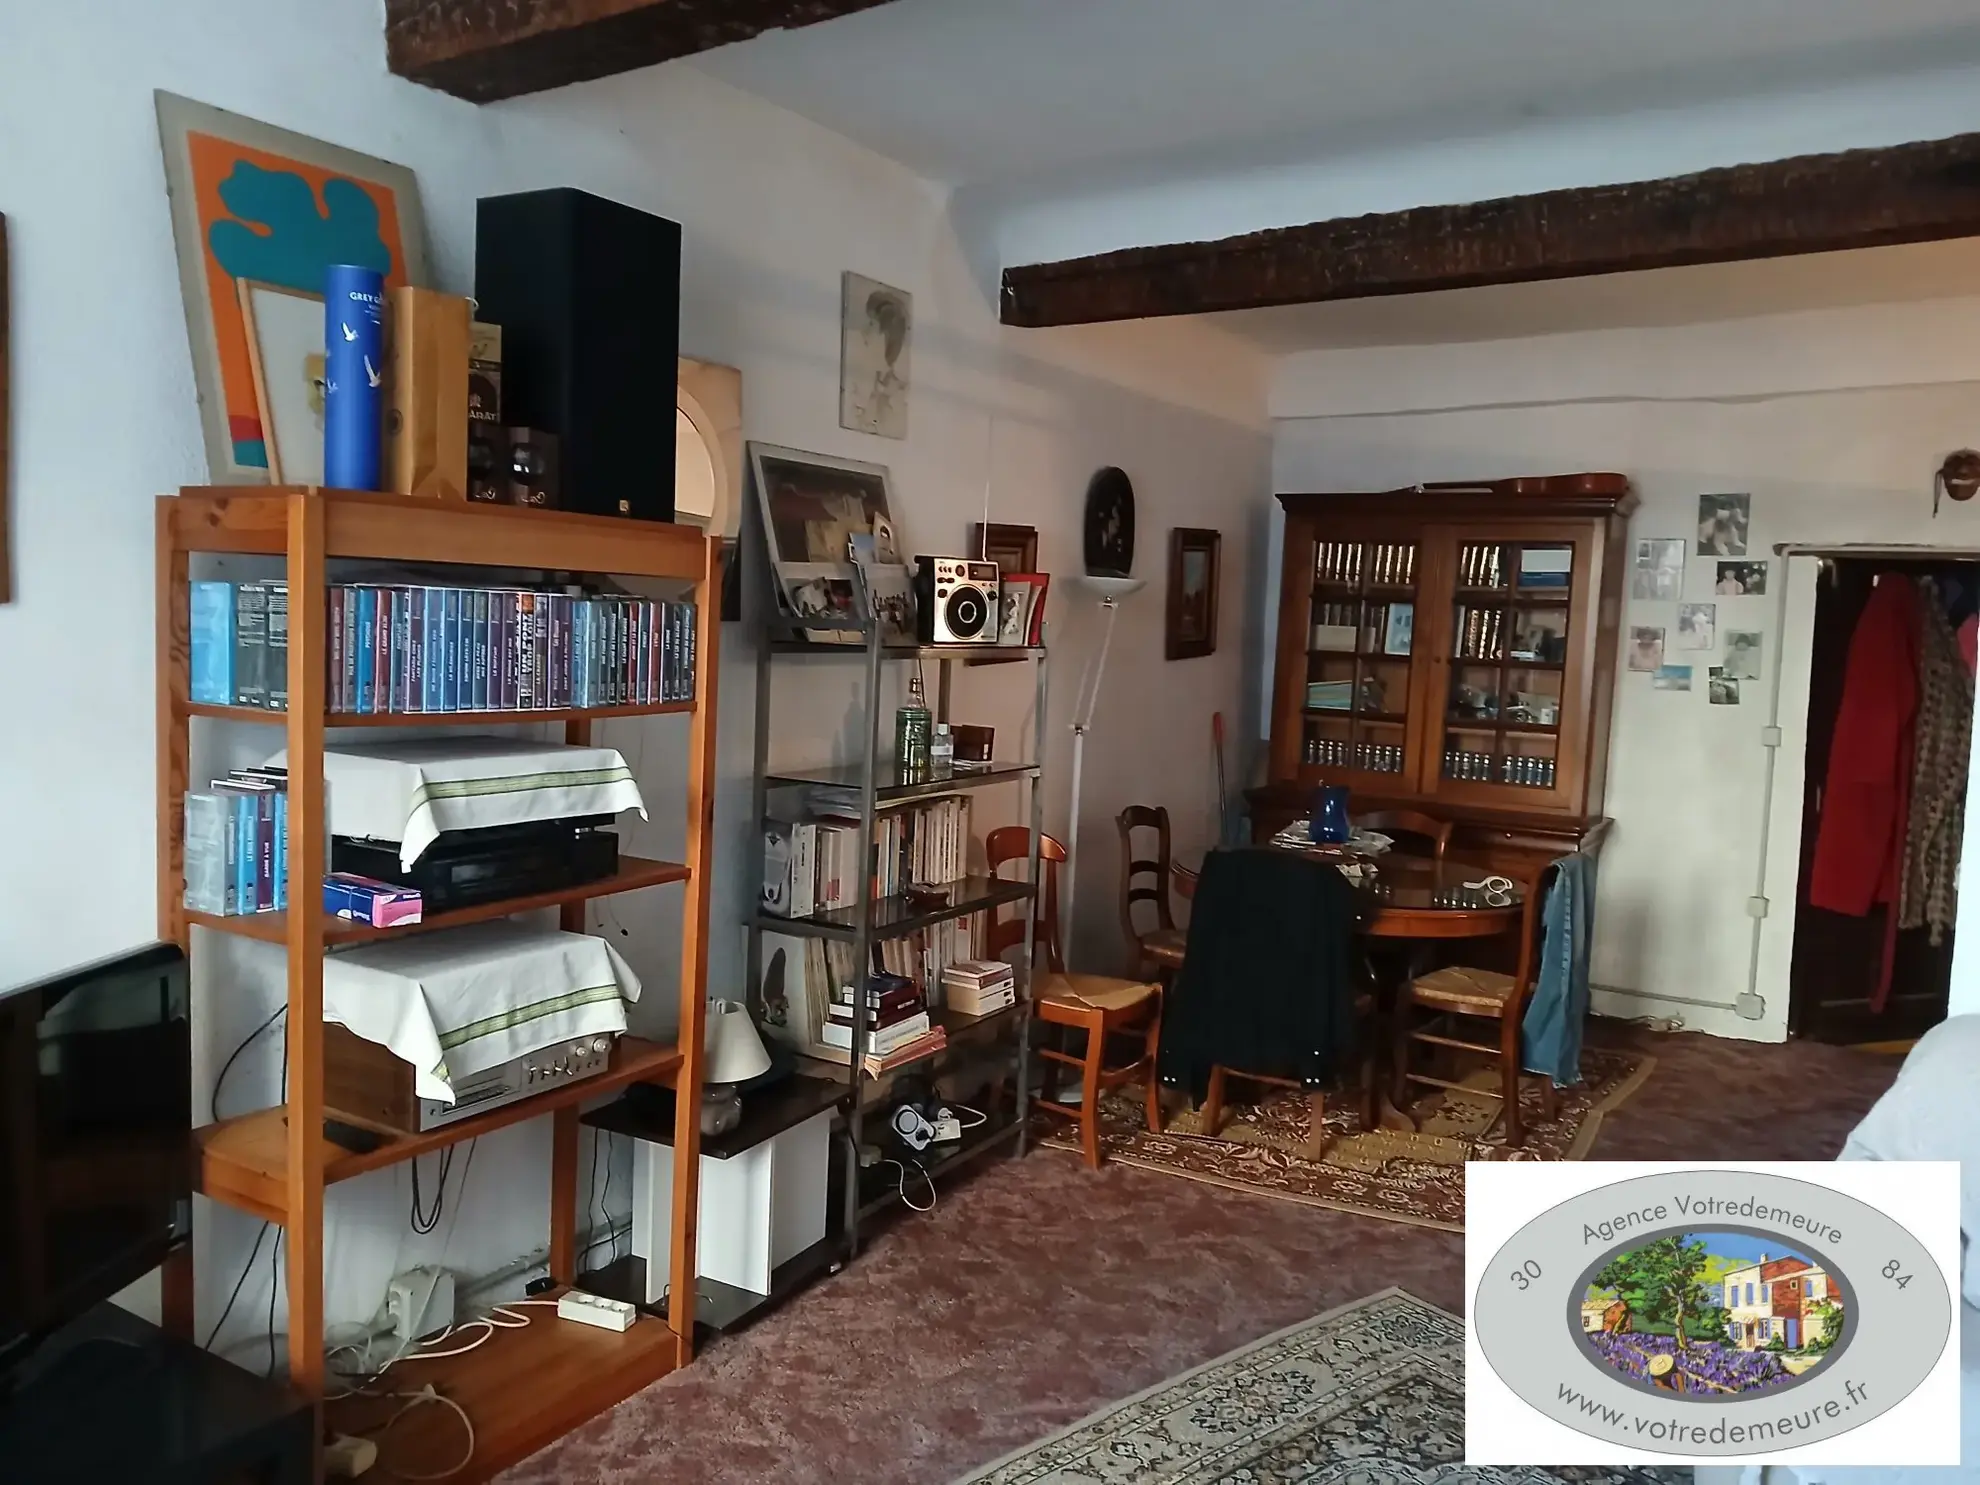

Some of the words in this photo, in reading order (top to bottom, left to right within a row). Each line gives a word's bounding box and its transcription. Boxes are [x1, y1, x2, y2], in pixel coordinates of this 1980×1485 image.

[349, 291, 373, 302] GREY
[469, 409, 497, 421] ARAT
[522, 654, 527, 673] UN
